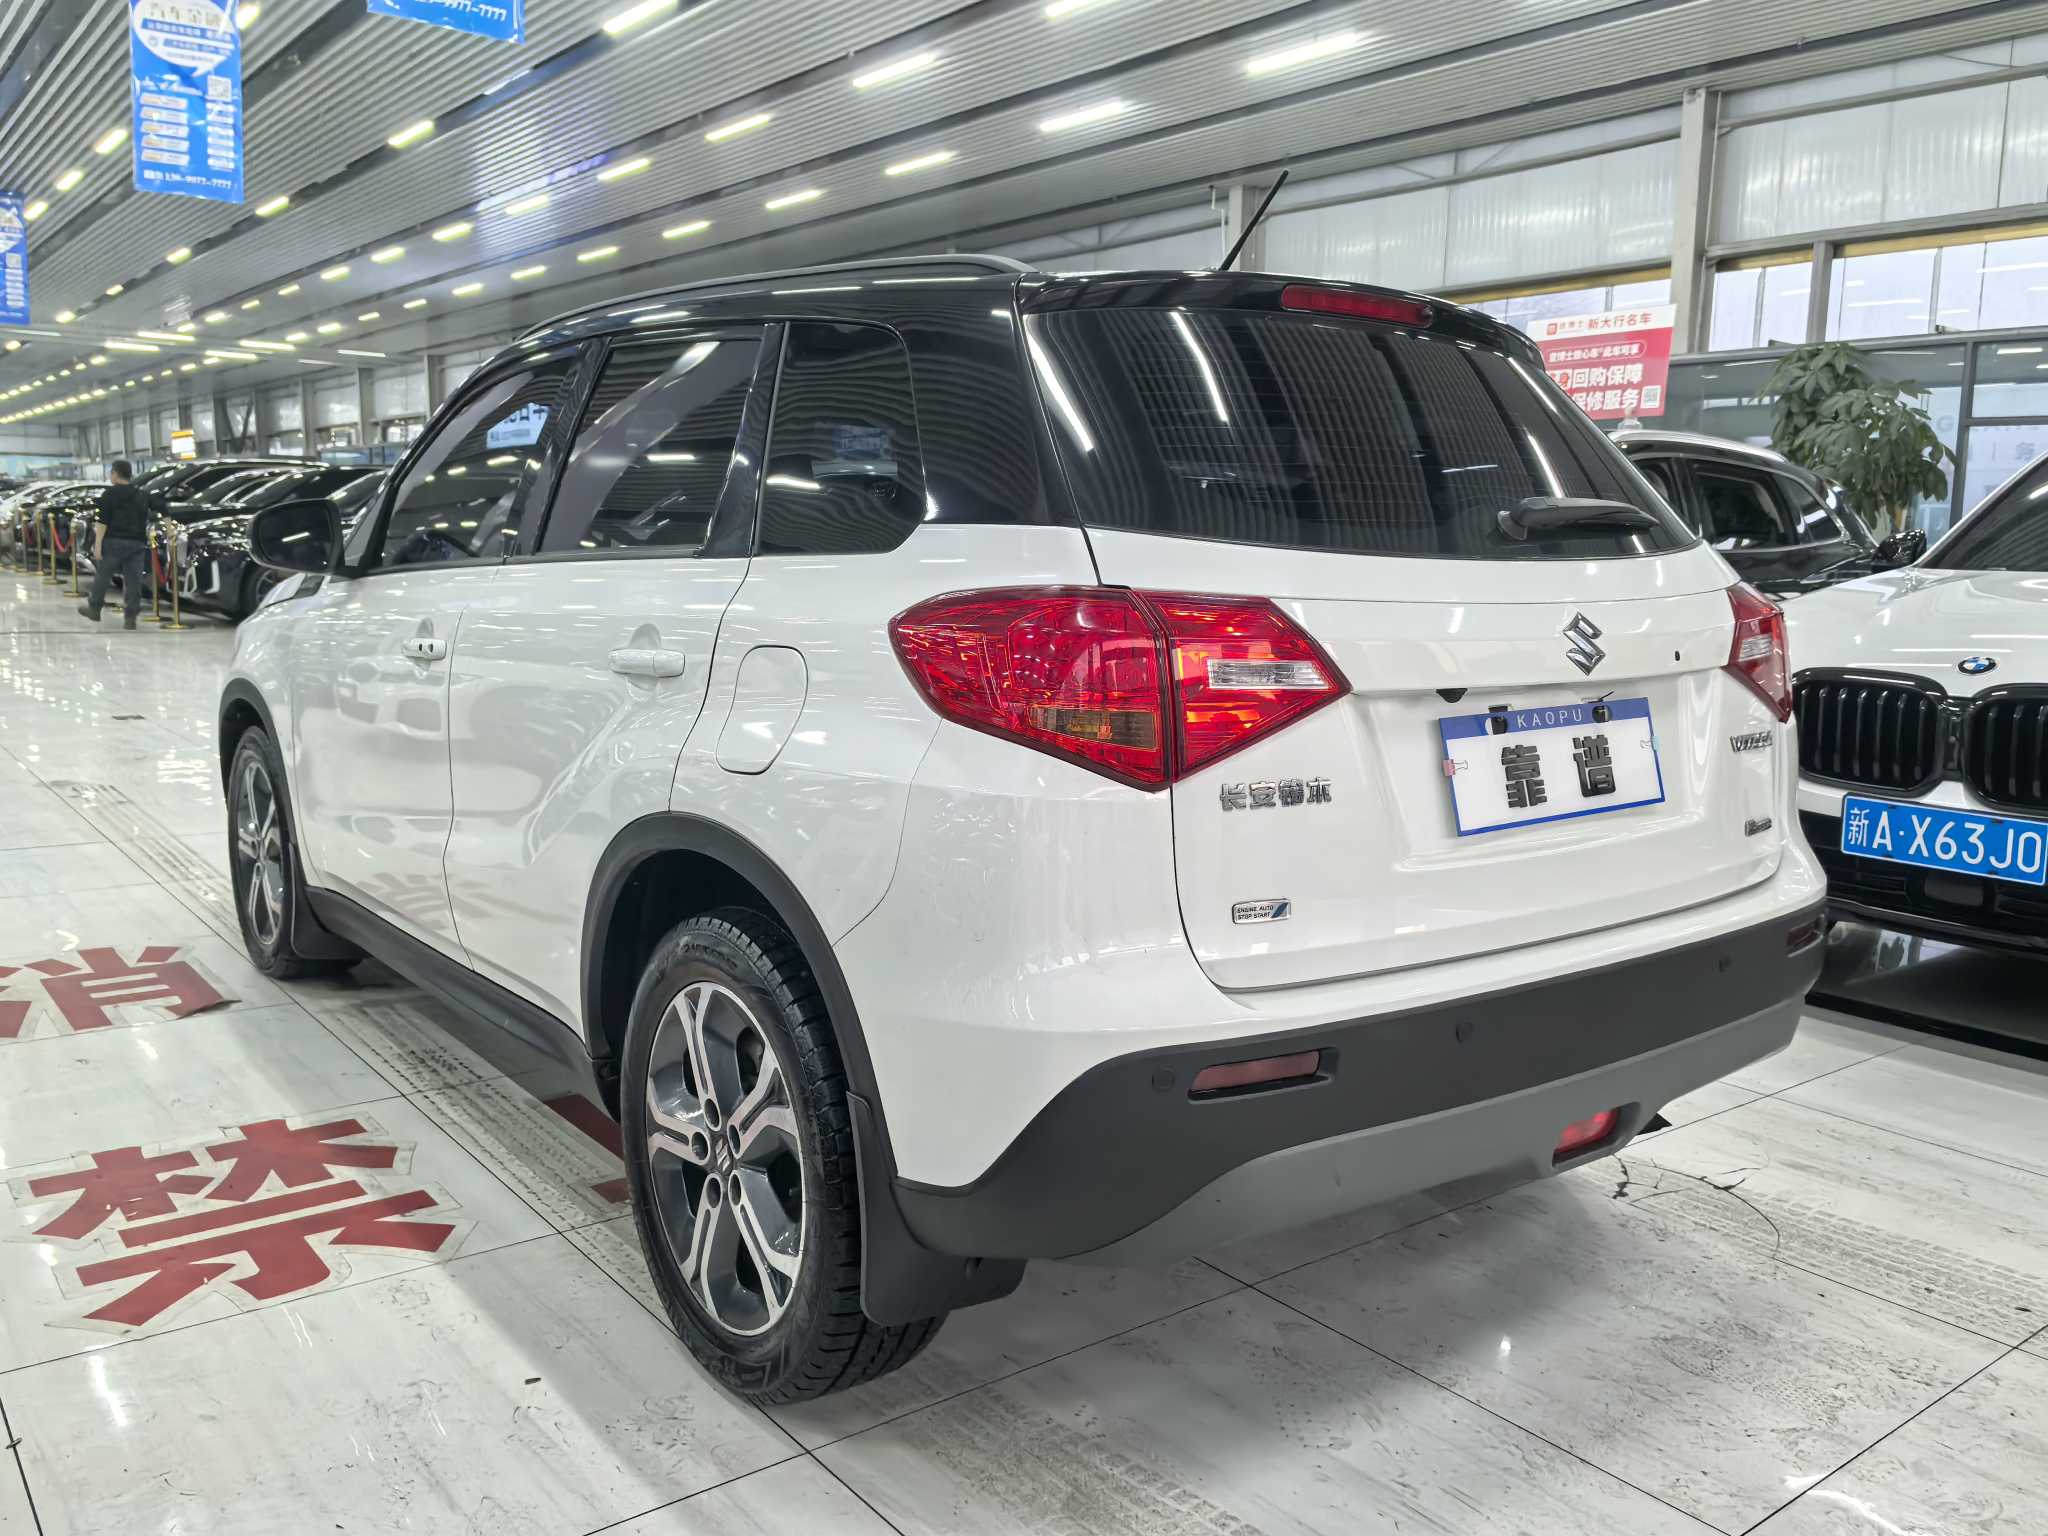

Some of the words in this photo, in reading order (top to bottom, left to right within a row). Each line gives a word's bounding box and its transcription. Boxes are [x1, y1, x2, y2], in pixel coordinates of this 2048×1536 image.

[1588, 313, 1652, 330] 新大行名车
[1515, 708, 1584, 729] KAOPU
[1500, 733, 1617, 808] 靠谱
[1253, 911, 1271, 919] START
[1259, 904, 1274, 912] AUTO
[29, 1118, 457, 1327] 禁
